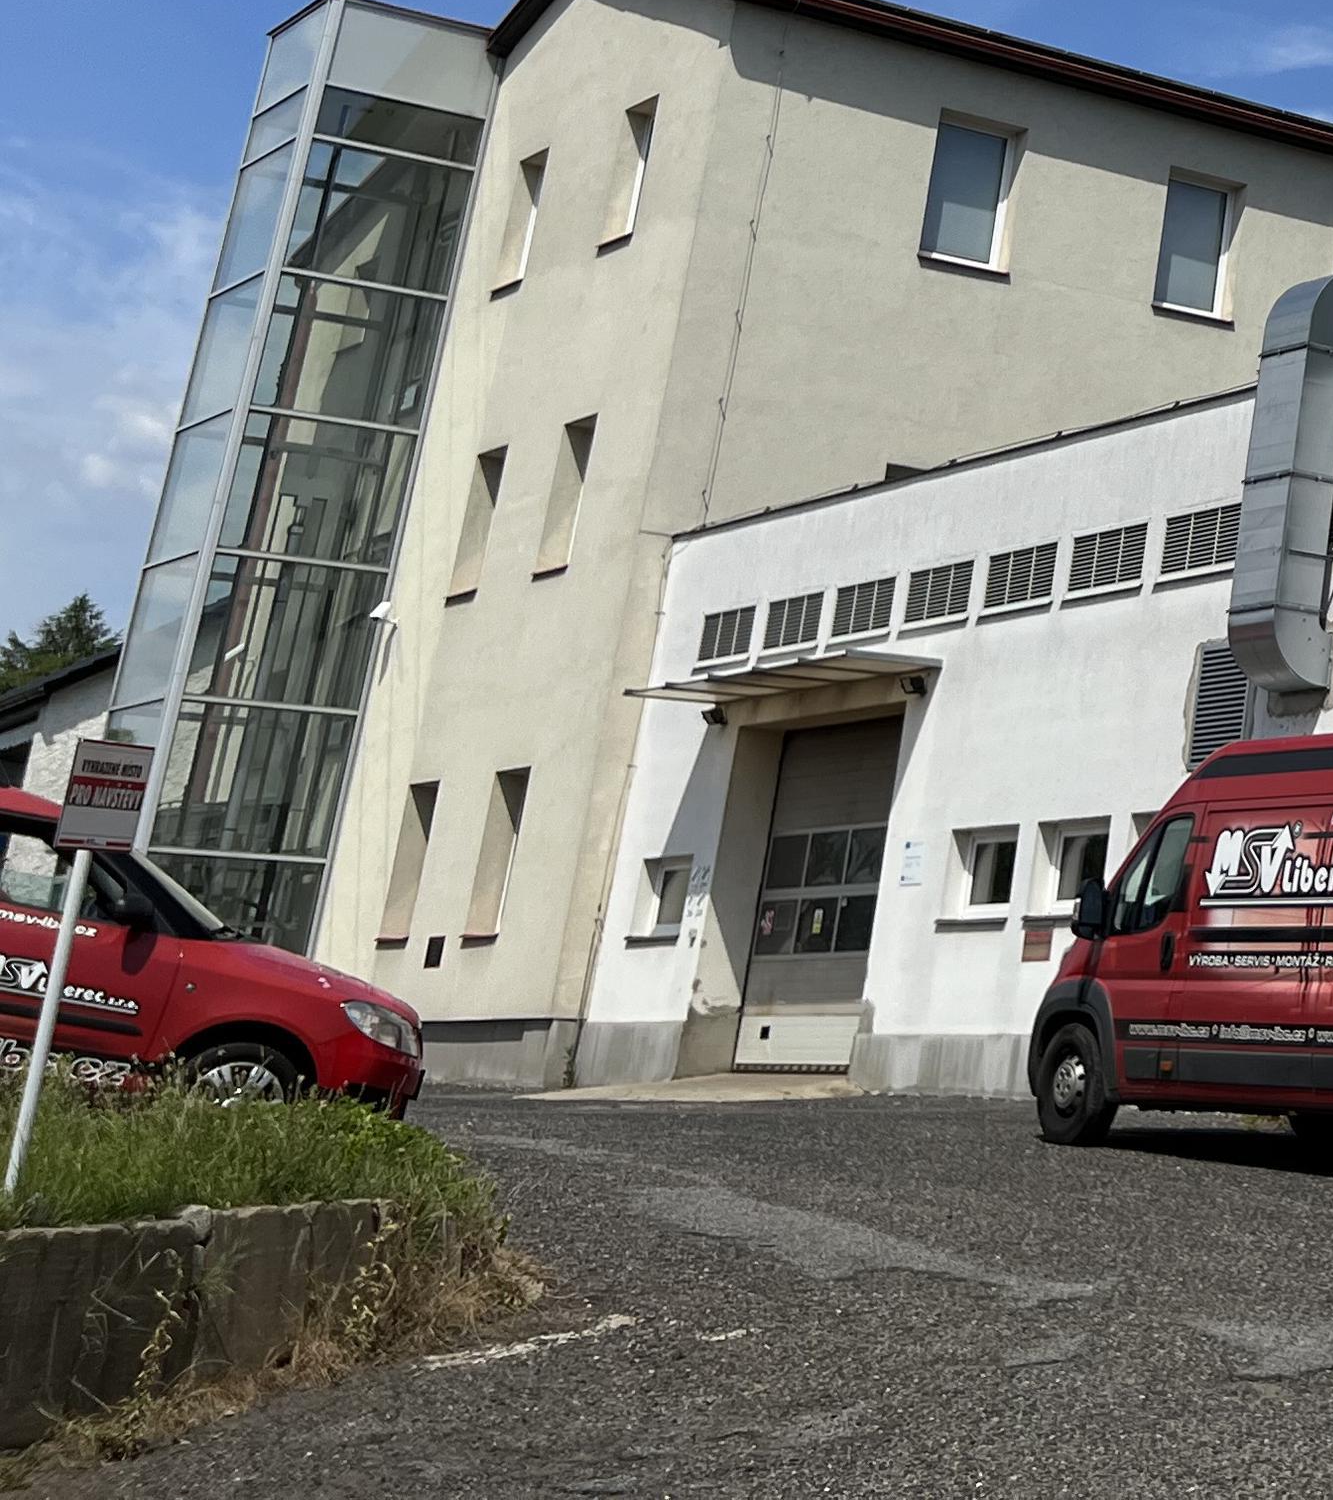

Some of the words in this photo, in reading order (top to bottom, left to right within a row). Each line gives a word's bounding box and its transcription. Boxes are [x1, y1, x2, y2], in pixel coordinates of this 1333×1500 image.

[69, 783, 93, 806] PRO
[91, 781, 143, 810] NÁVŠTĚVY
[1205, 824, 1294, 896] MSV
[1189, 953, 1229, 967] VÝROBA
[1233, 954, 1271, 967] SERVIS
[1275, 952, 1320, 967] MONTÁŽ
